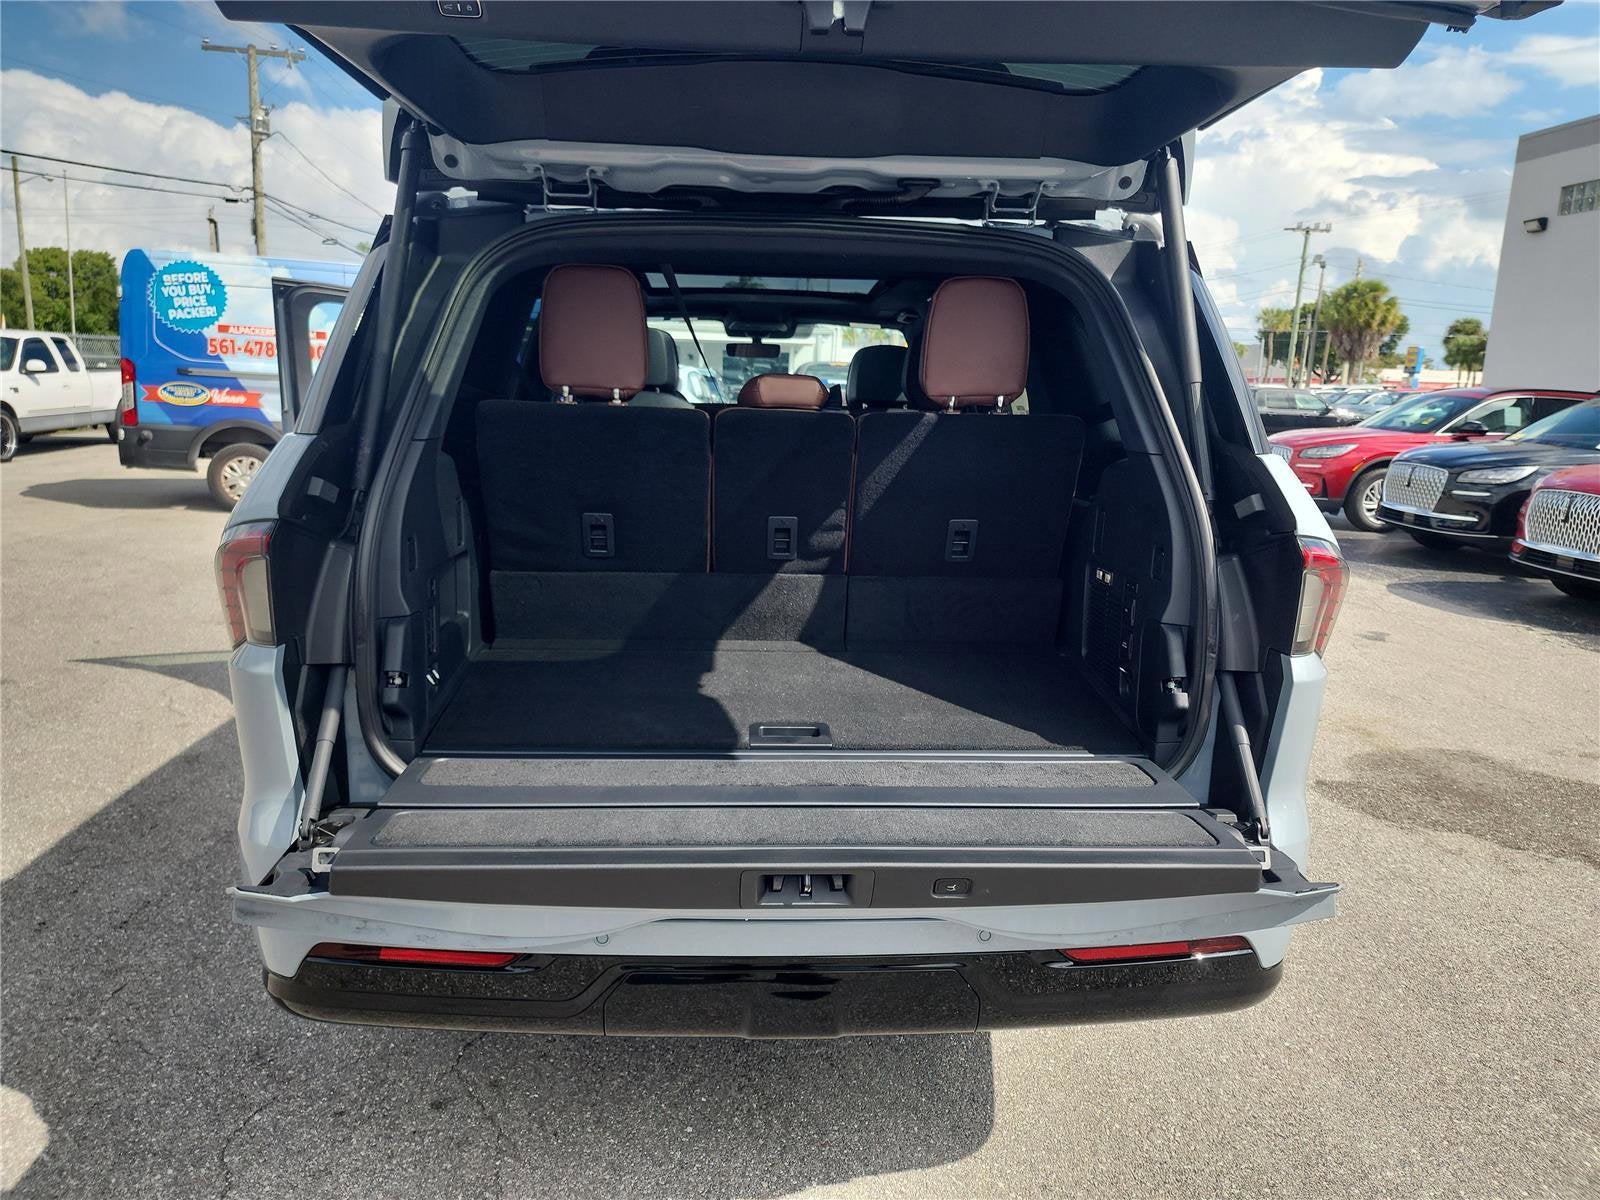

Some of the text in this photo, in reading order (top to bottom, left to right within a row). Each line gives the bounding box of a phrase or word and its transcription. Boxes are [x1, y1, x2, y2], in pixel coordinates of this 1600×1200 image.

[163, 272, 209, 285] BEFORE
[161, 283, 215, 297] YOU BUY,
[174, 295, 208, 308] PRICE
[168, 306, 217, 319] PACKER!
